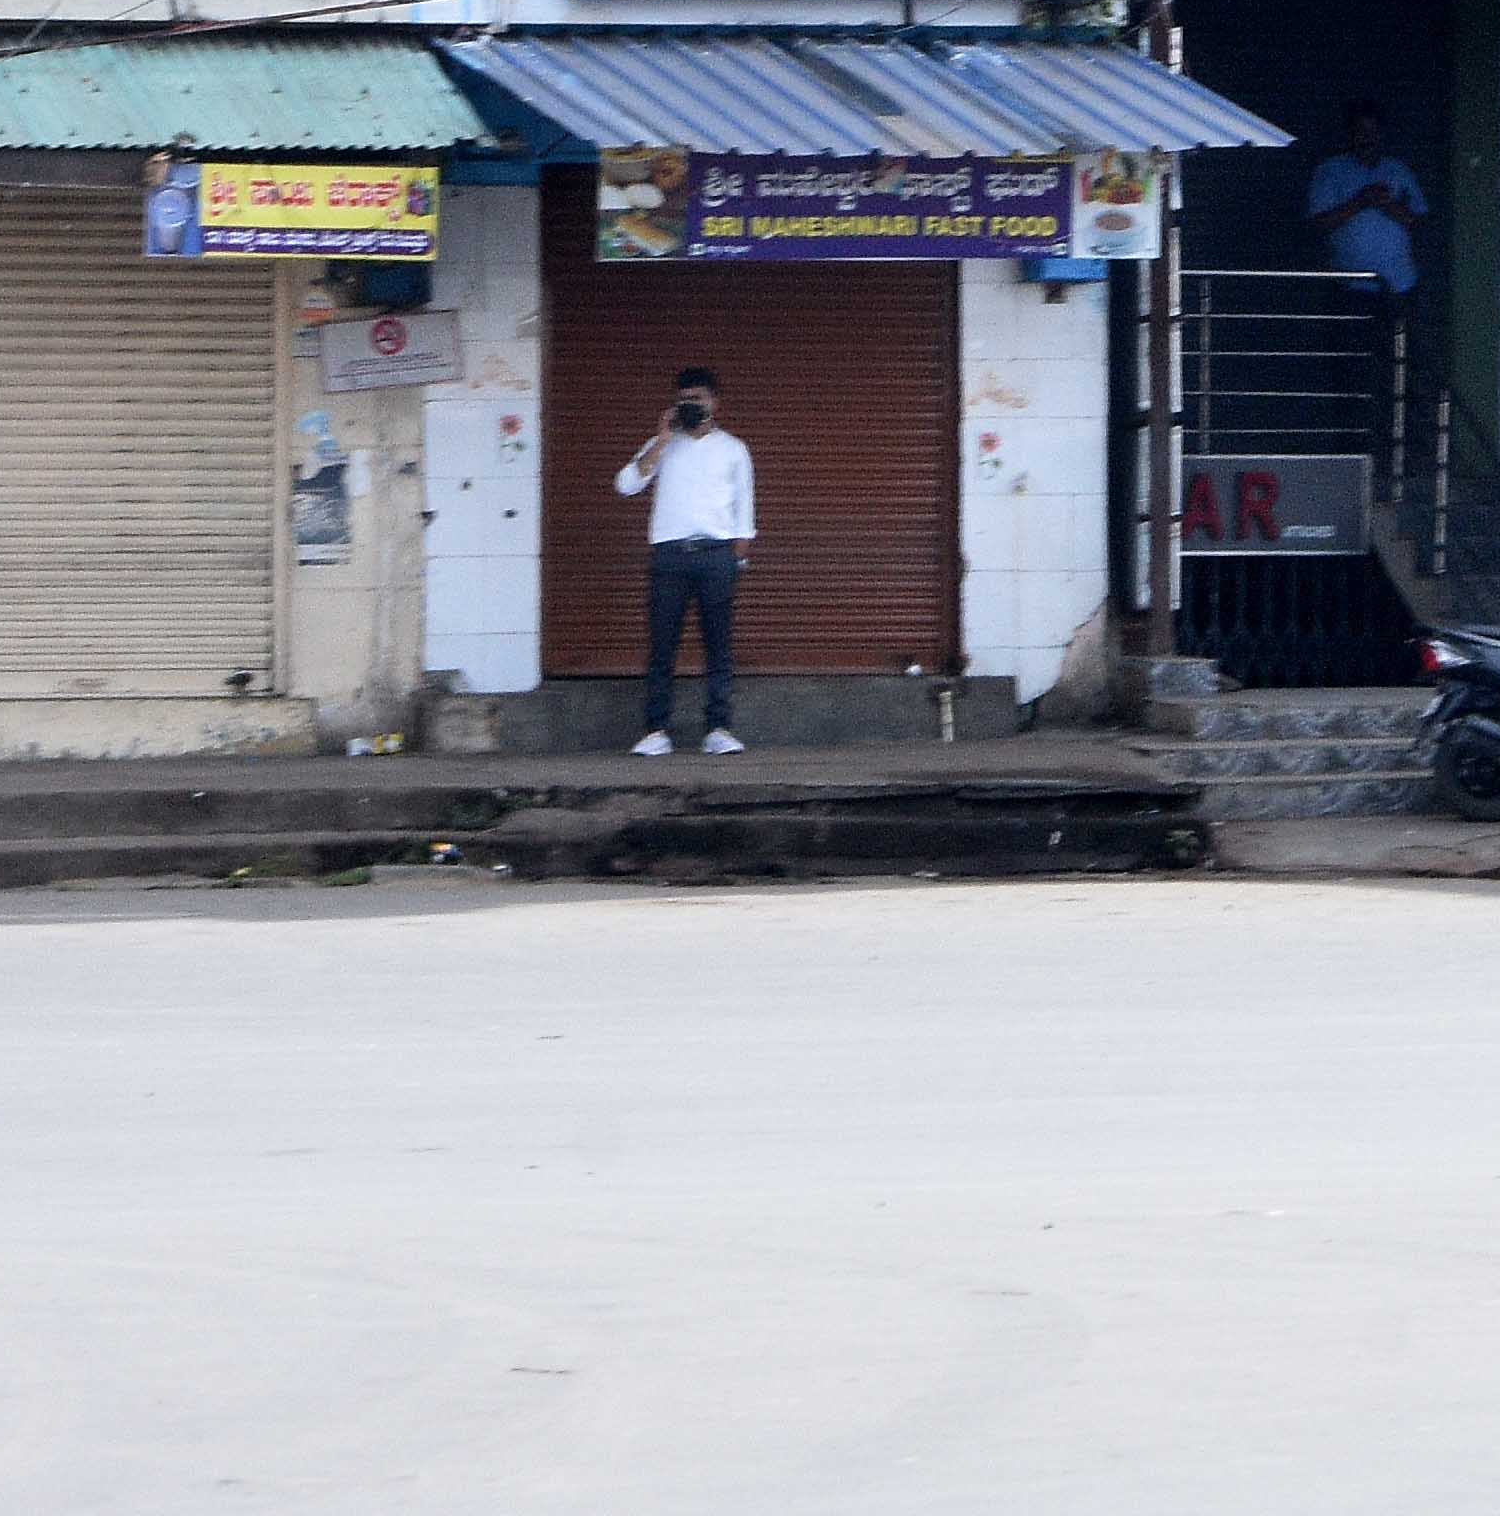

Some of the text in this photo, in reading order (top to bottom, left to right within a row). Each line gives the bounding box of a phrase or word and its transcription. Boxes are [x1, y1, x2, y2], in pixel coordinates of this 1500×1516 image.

[699, 215, 1060, 239] SRI MAHESHWARI FAST FOOD
[1181, 468, 1281, 542] AR
